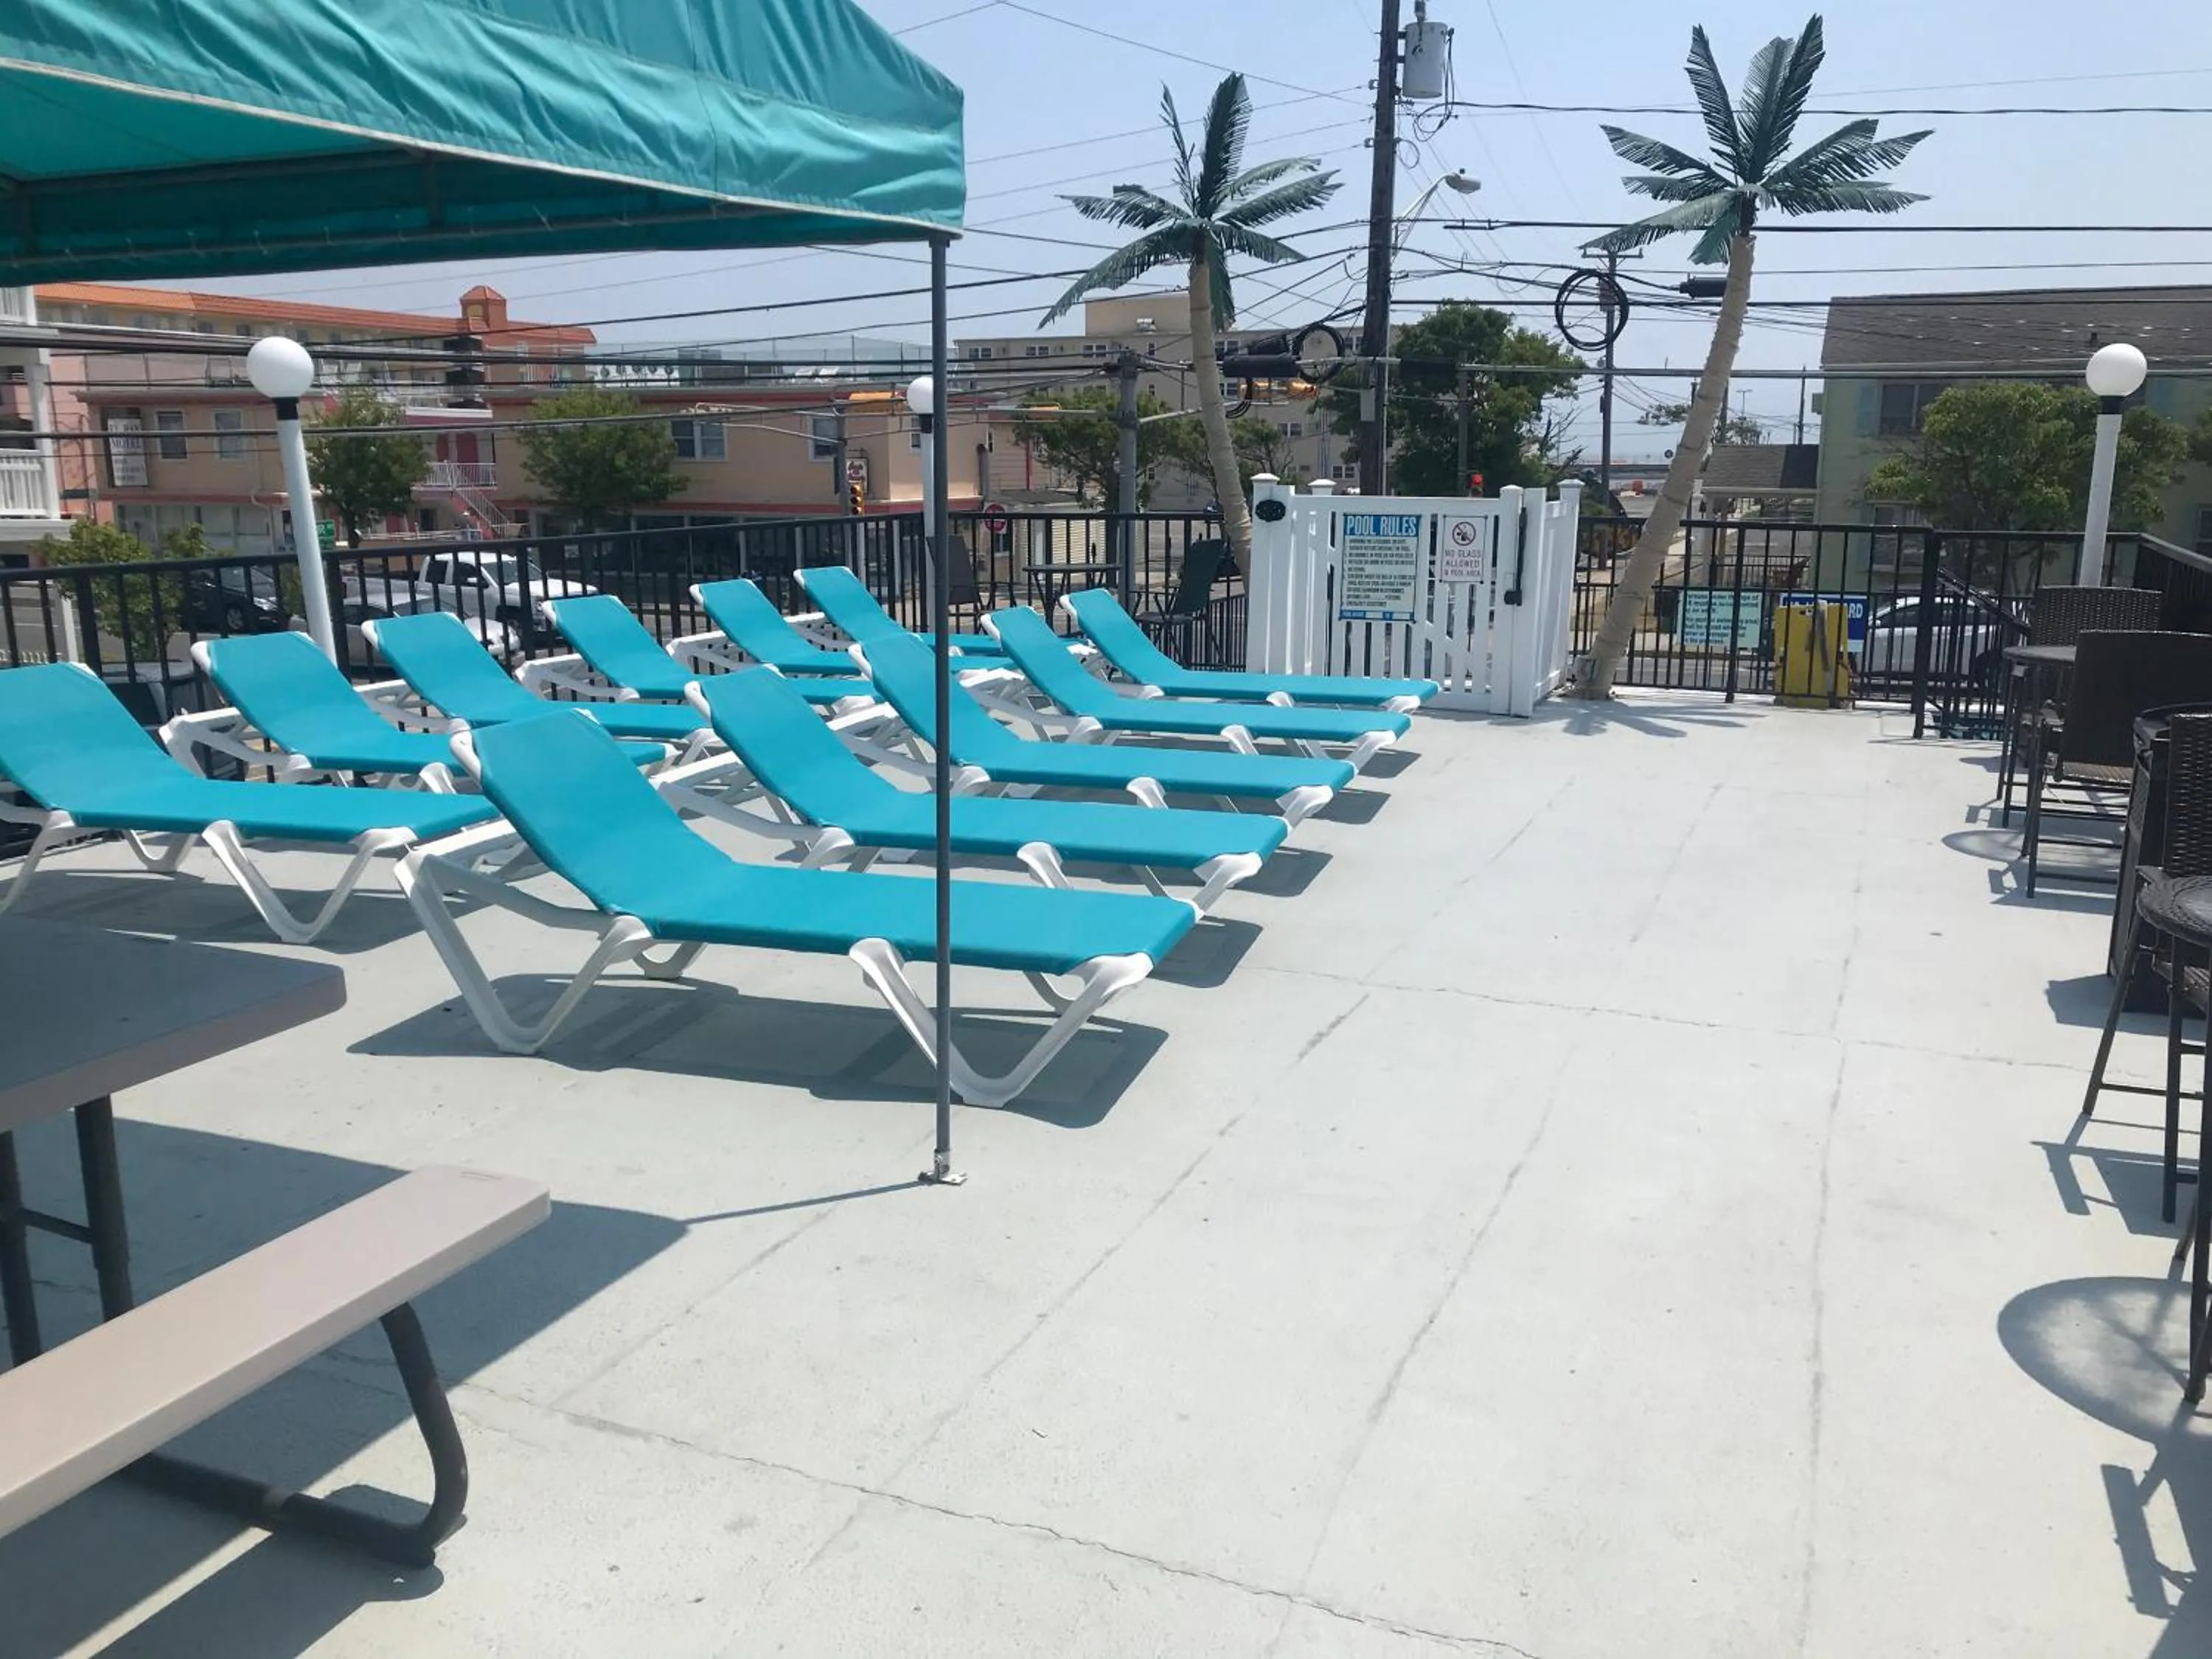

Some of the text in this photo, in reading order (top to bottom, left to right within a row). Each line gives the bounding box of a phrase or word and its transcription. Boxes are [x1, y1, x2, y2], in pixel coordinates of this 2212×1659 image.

[1347, 515, 1416, 537] POOL RULES
[1445, 549, 1481, 558] NO GLASS
[1445, 559, 1480, 568] ALLOWED
